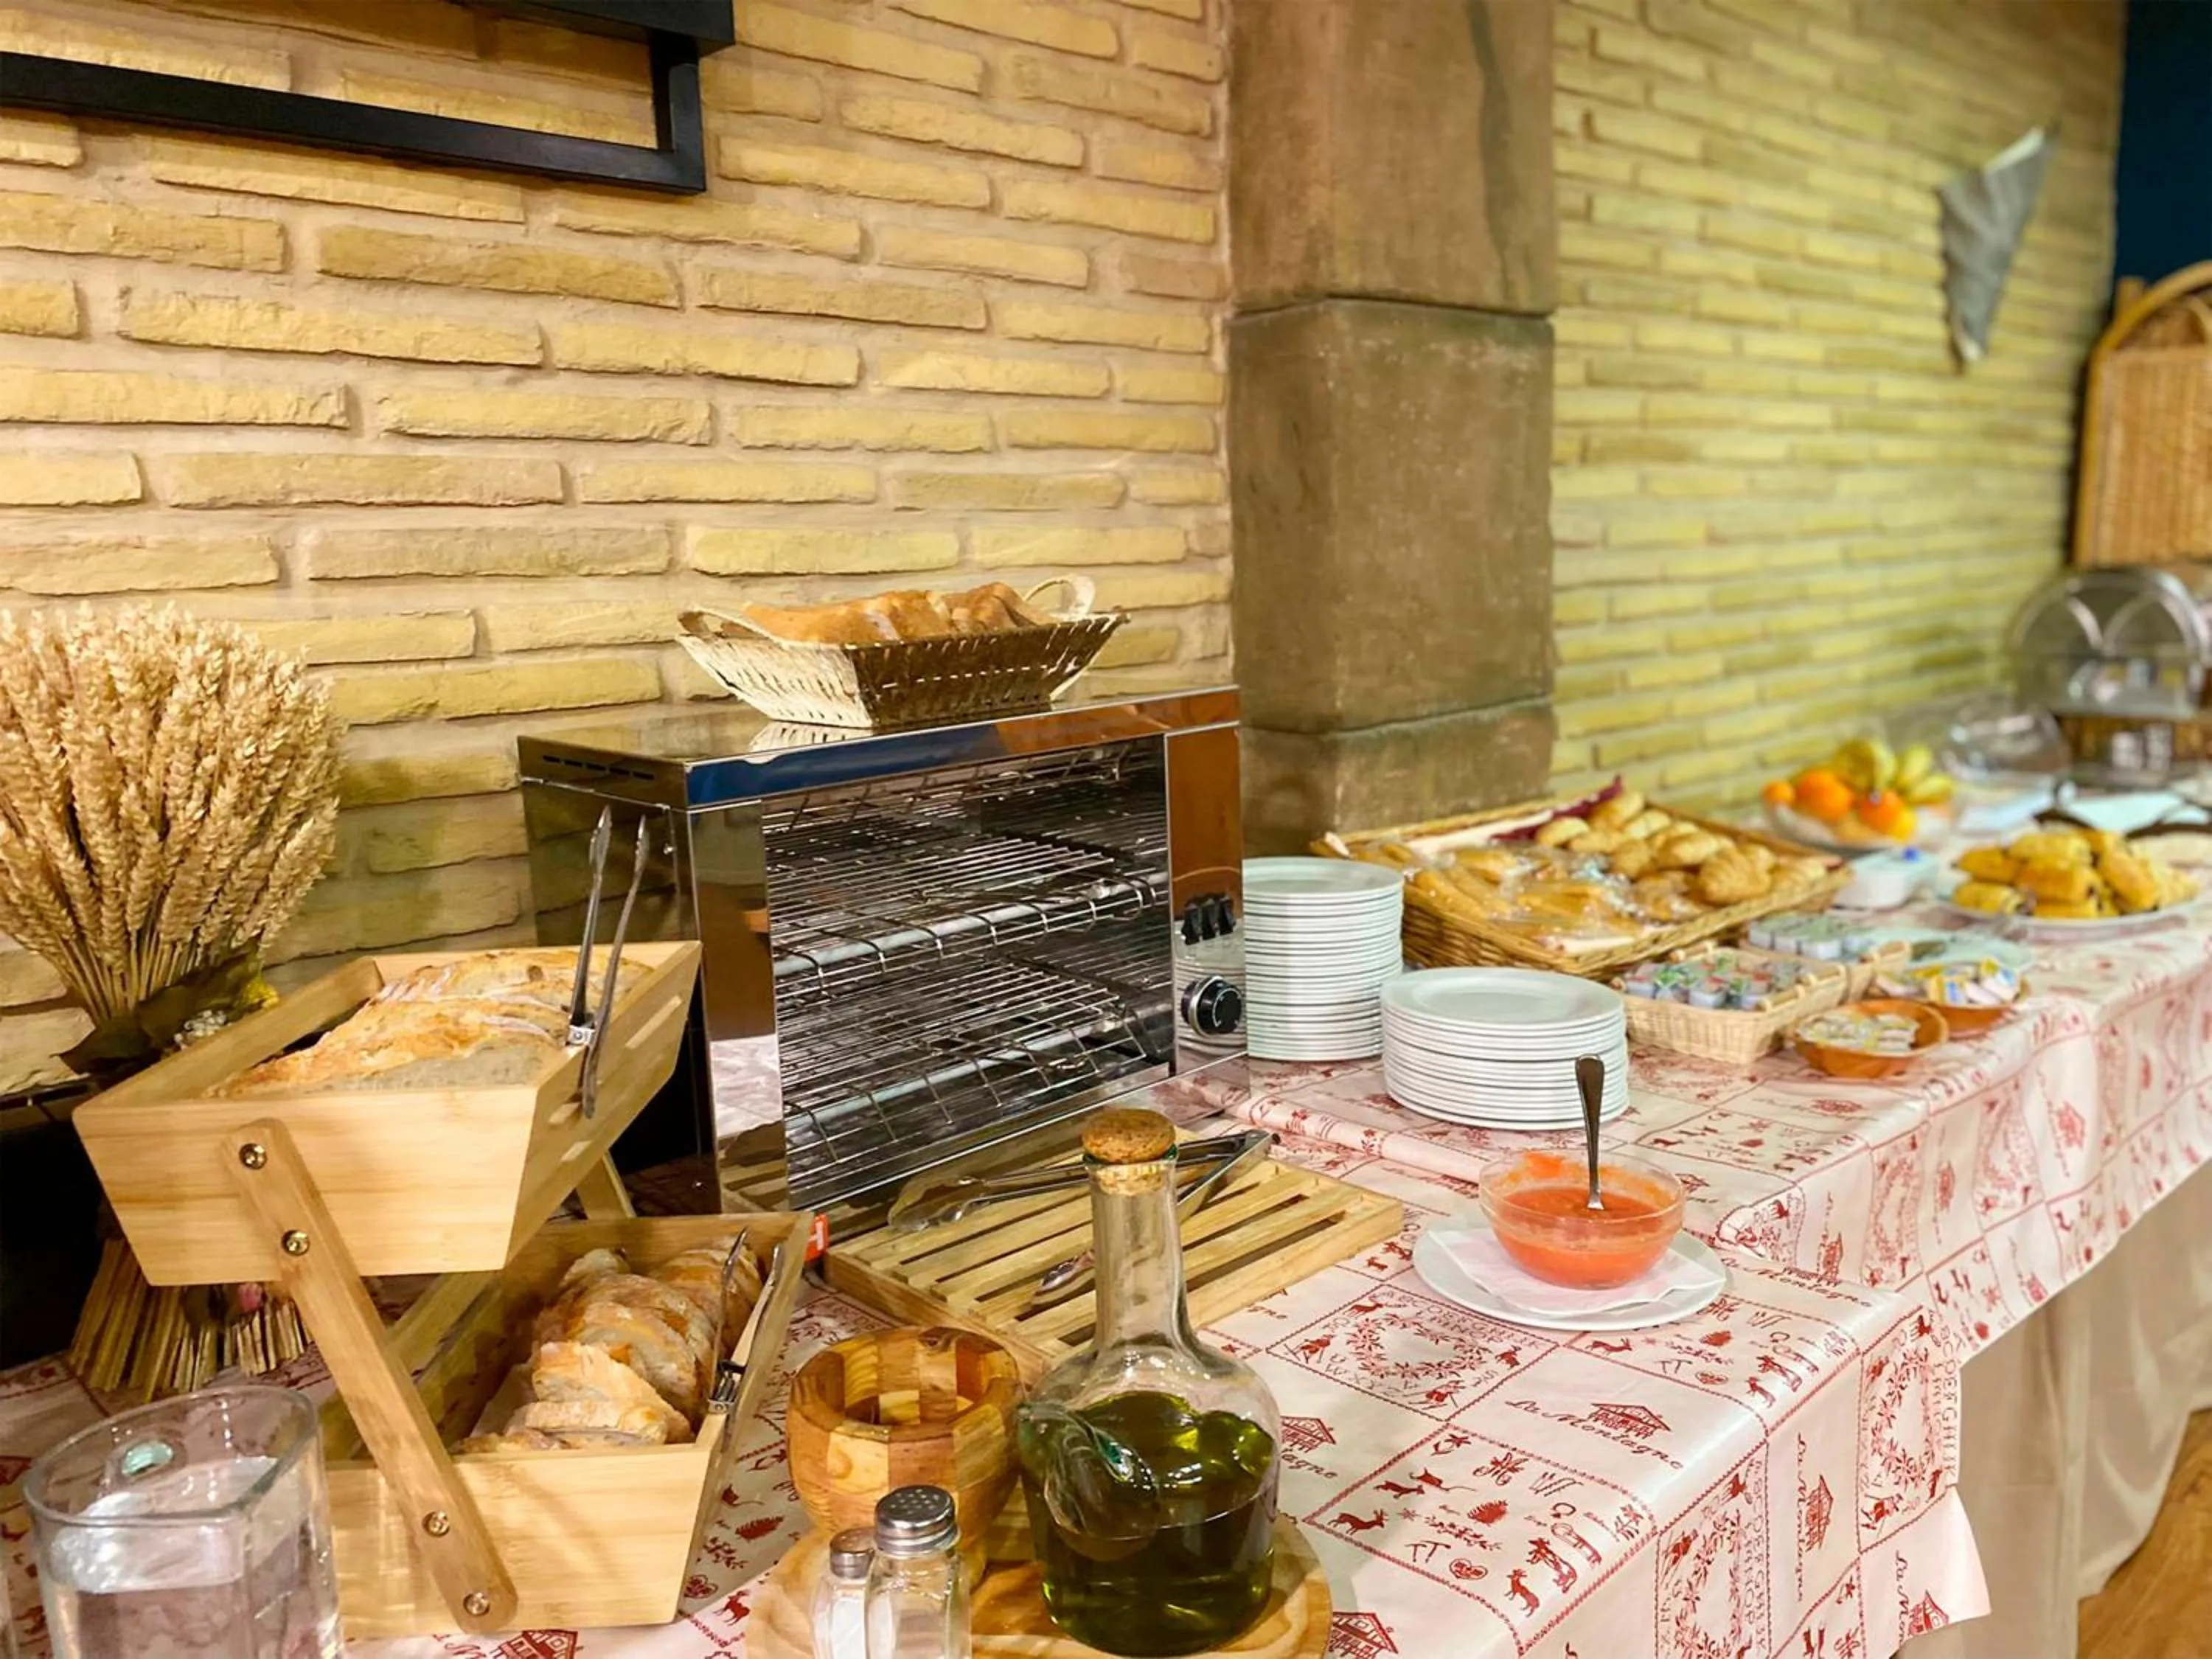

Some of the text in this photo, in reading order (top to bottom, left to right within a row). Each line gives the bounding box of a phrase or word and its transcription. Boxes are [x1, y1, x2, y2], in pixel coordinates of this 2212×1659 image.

[1505, 1400, 1683, 1470] La Montagne
[1895, 1550, 1908, 1582] La
